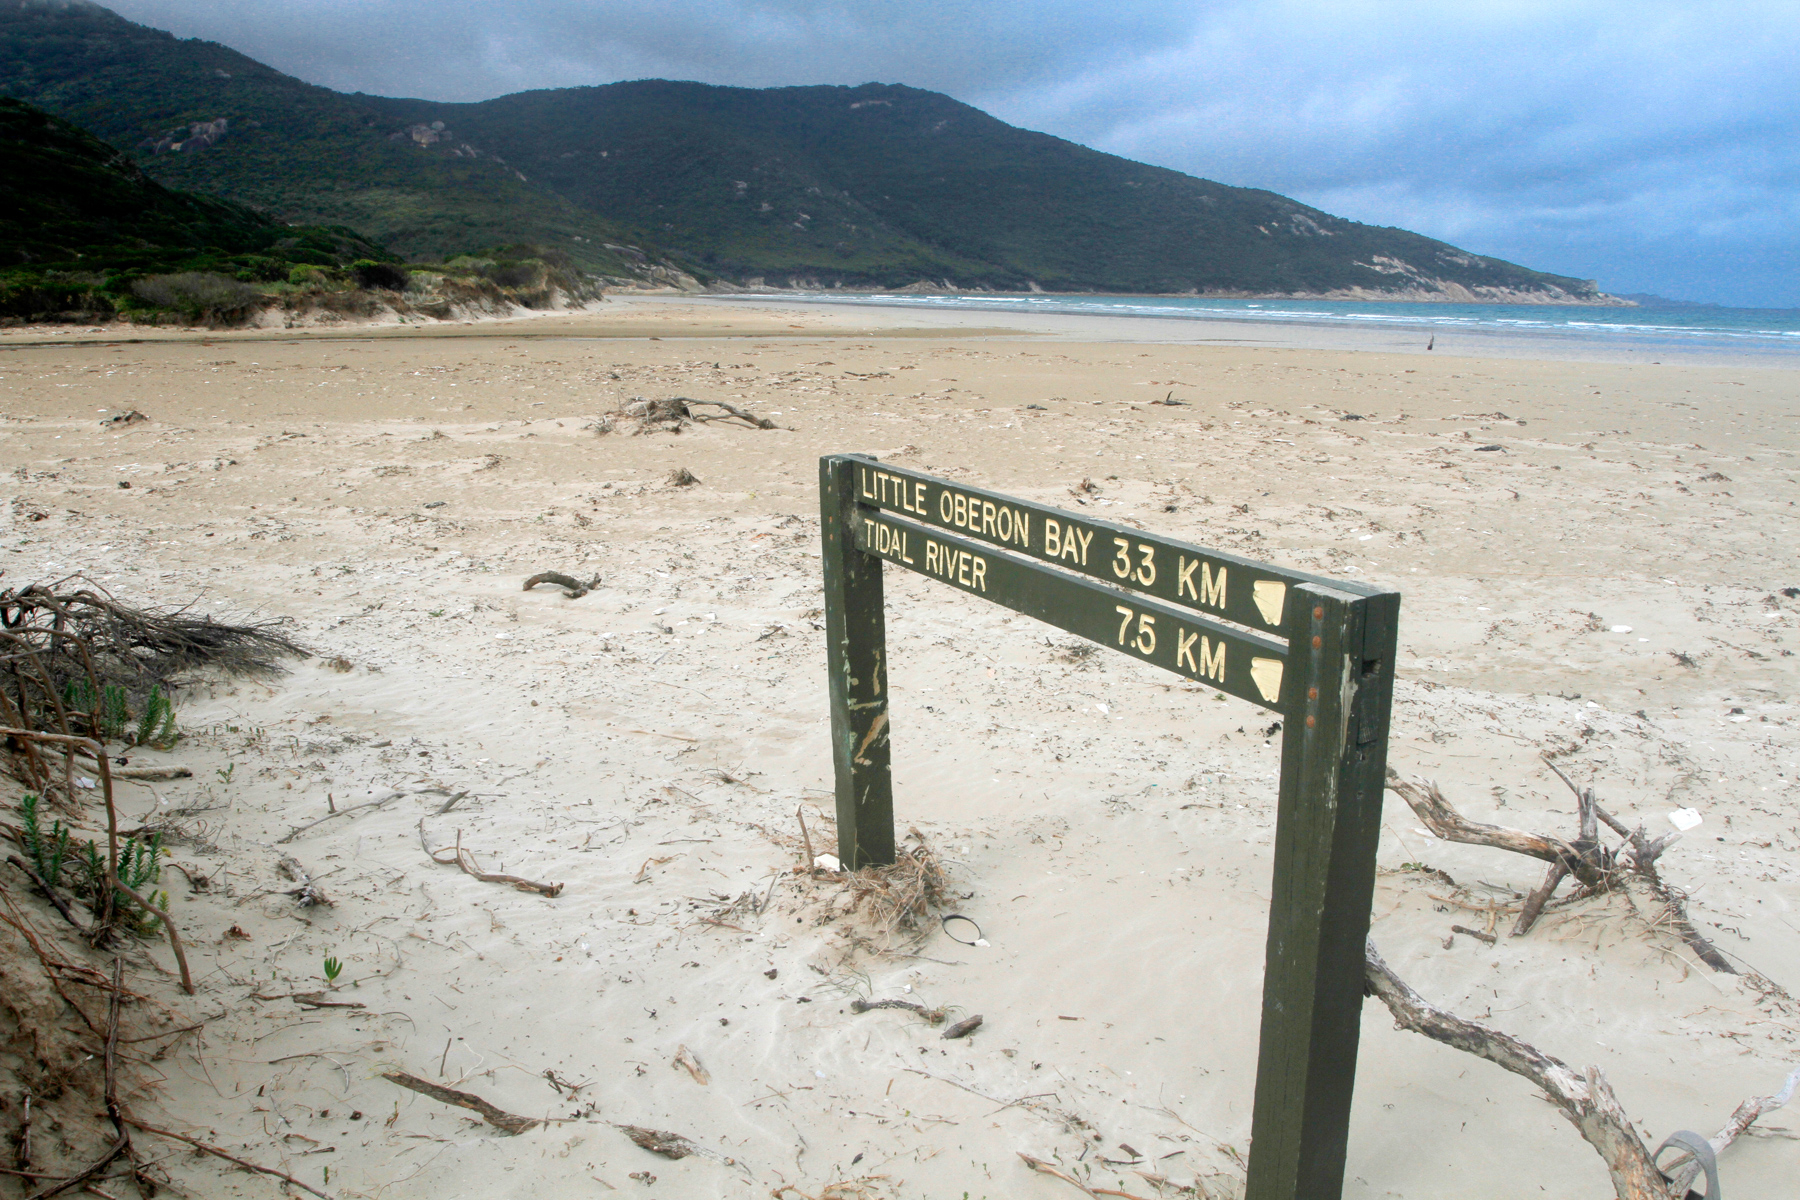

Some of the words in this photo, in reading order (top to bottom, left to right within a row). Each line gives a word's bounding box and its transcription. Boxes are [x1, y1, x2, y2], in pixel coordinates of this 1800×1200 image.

[860, 467, 928, 516] LITTLE
[939, 490, 1030, 548] OBERON
[1044, 518, 1093, 567] BAY
[1112, 537, 1157, 587] 3.3
[1177, 556, 1228, 610] KM
[863, 517, 914, 565] TIDAL
[925, 539, 987, 593] RIVER
[1115, 605, 1157, 656] 7.5
[1176, 628, 1227, 684] KM
